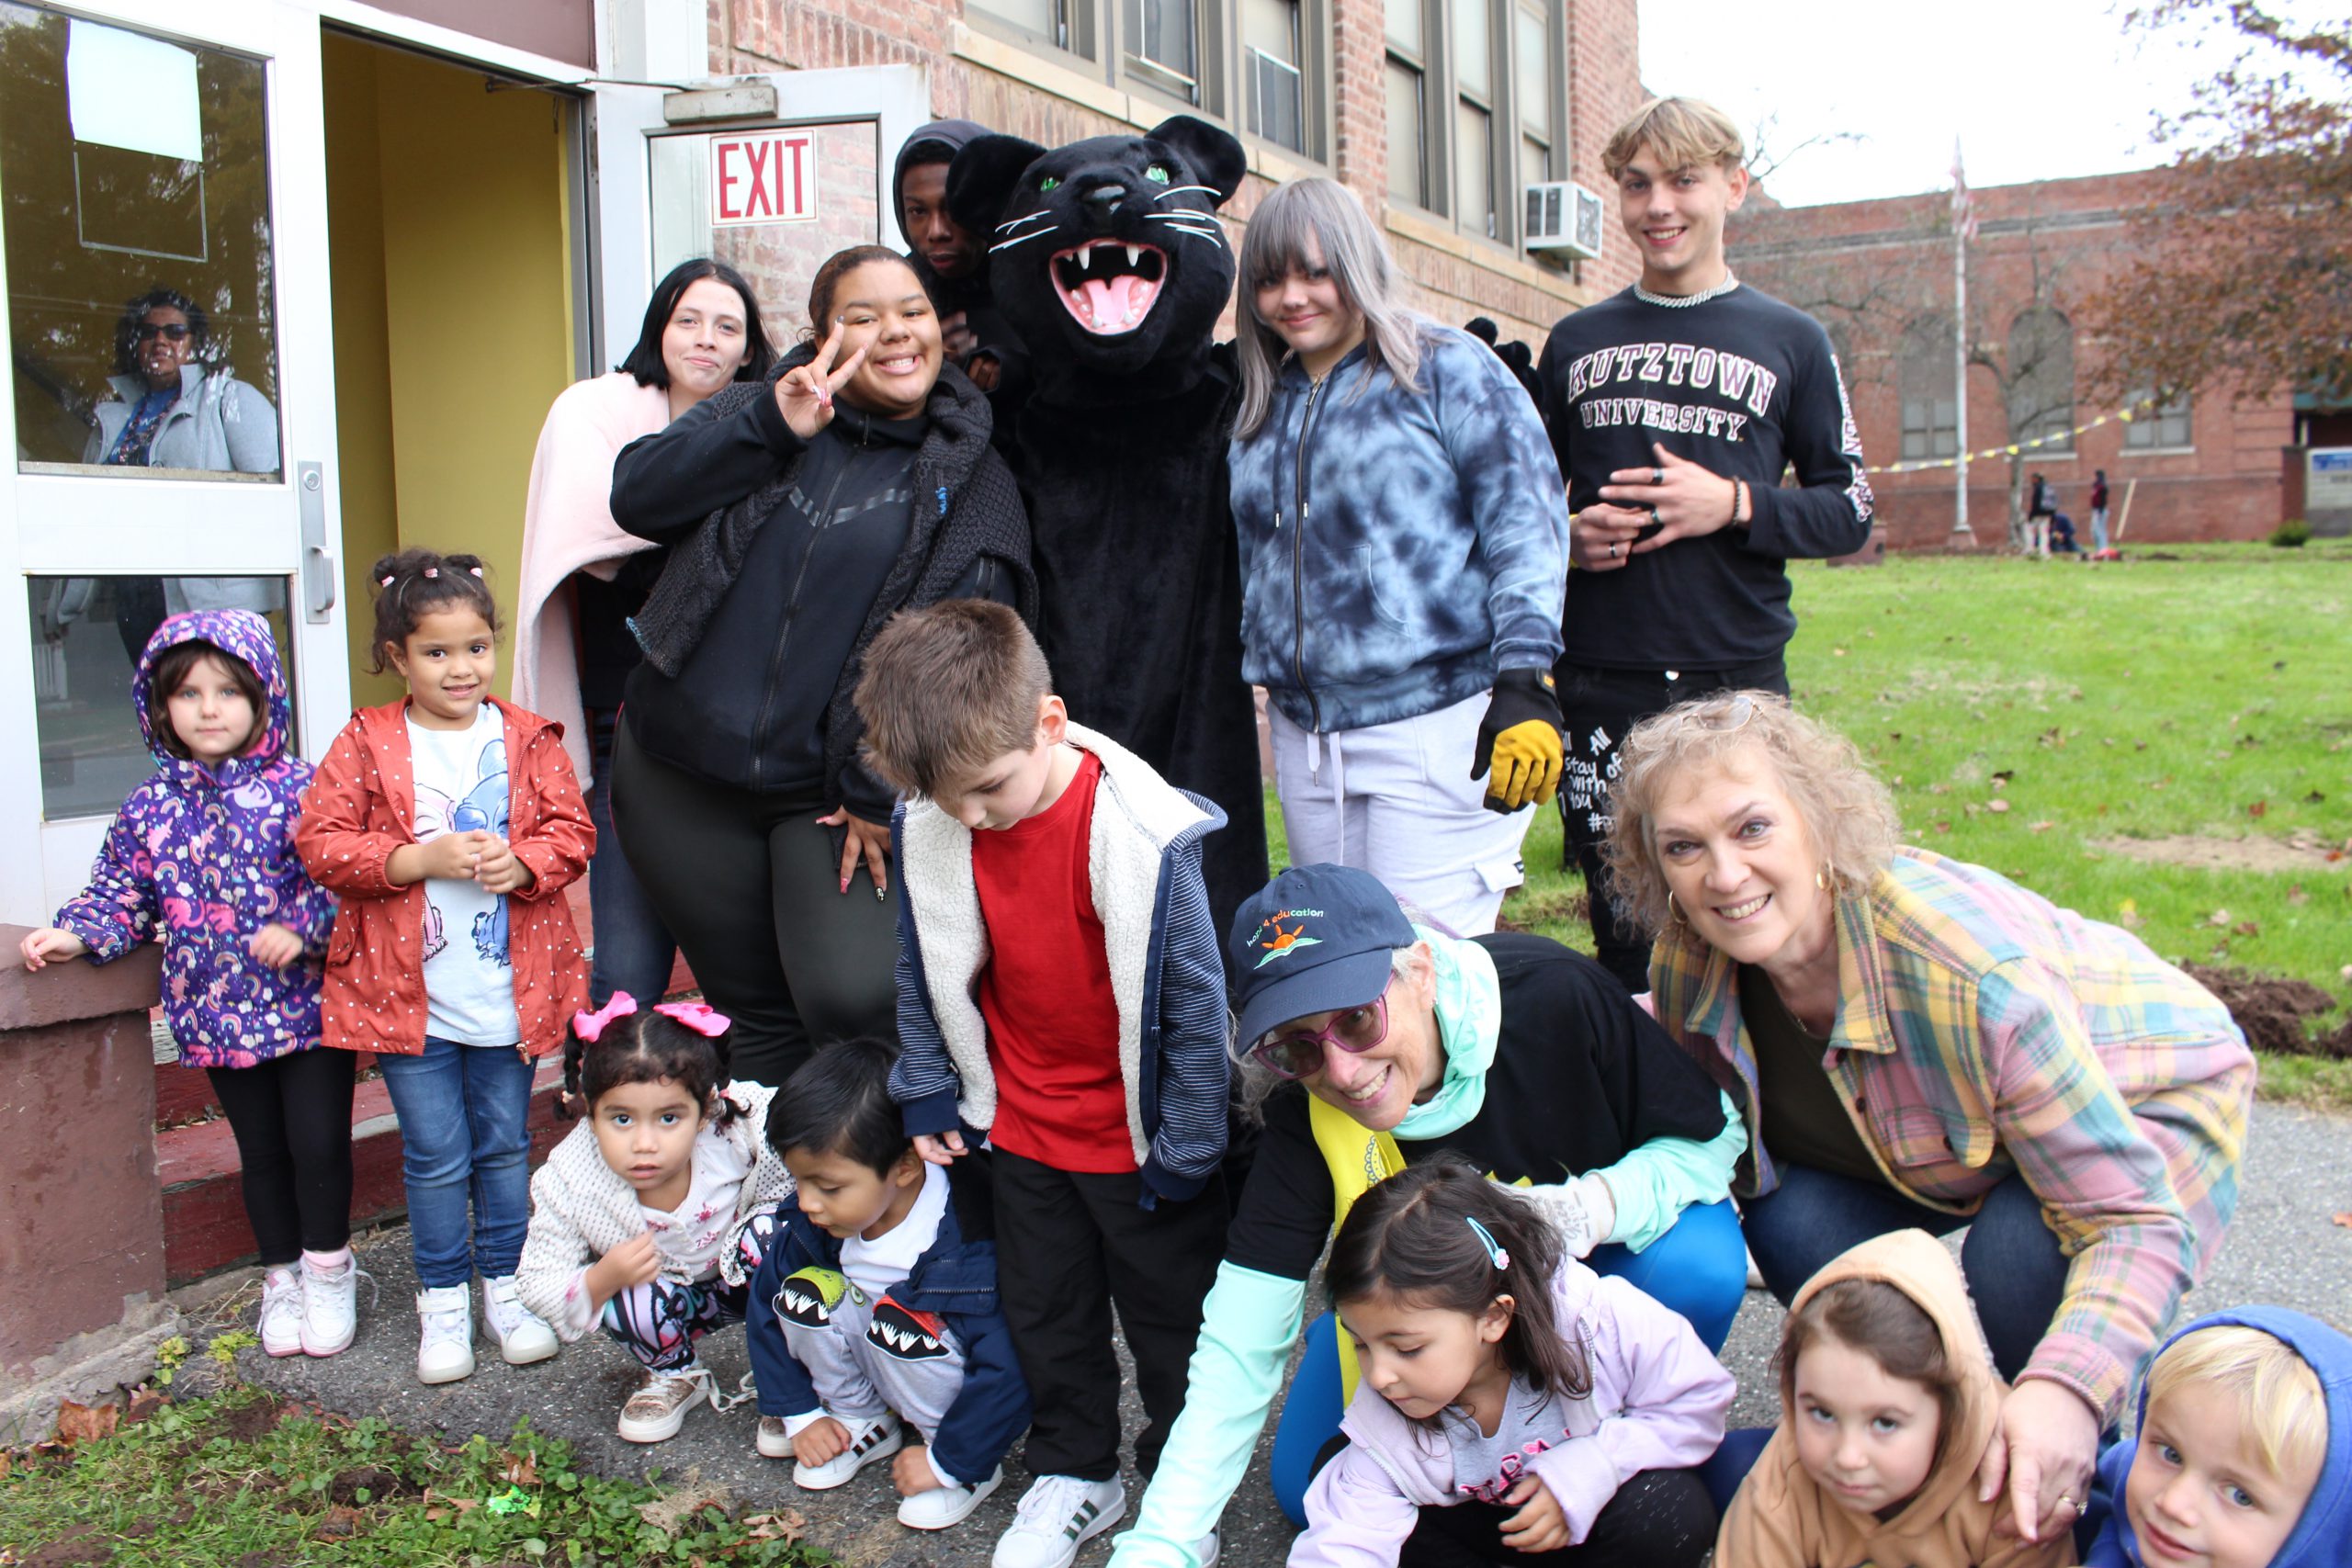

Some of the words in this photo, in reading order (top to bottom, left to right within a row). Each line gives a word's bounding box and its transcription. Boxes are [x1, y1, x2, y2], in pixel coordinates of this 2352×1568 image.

[718, 138, 808, 220] EXIT
[1567, 343, 1777, 418] KUTZTOWN
[1579, 398, 1748, 442] UNIVERSITY
[1565, 756, 1599, 778] stay
[1263, 919, 1271, 927] 4
[1272, 908, 1324, 923] education
